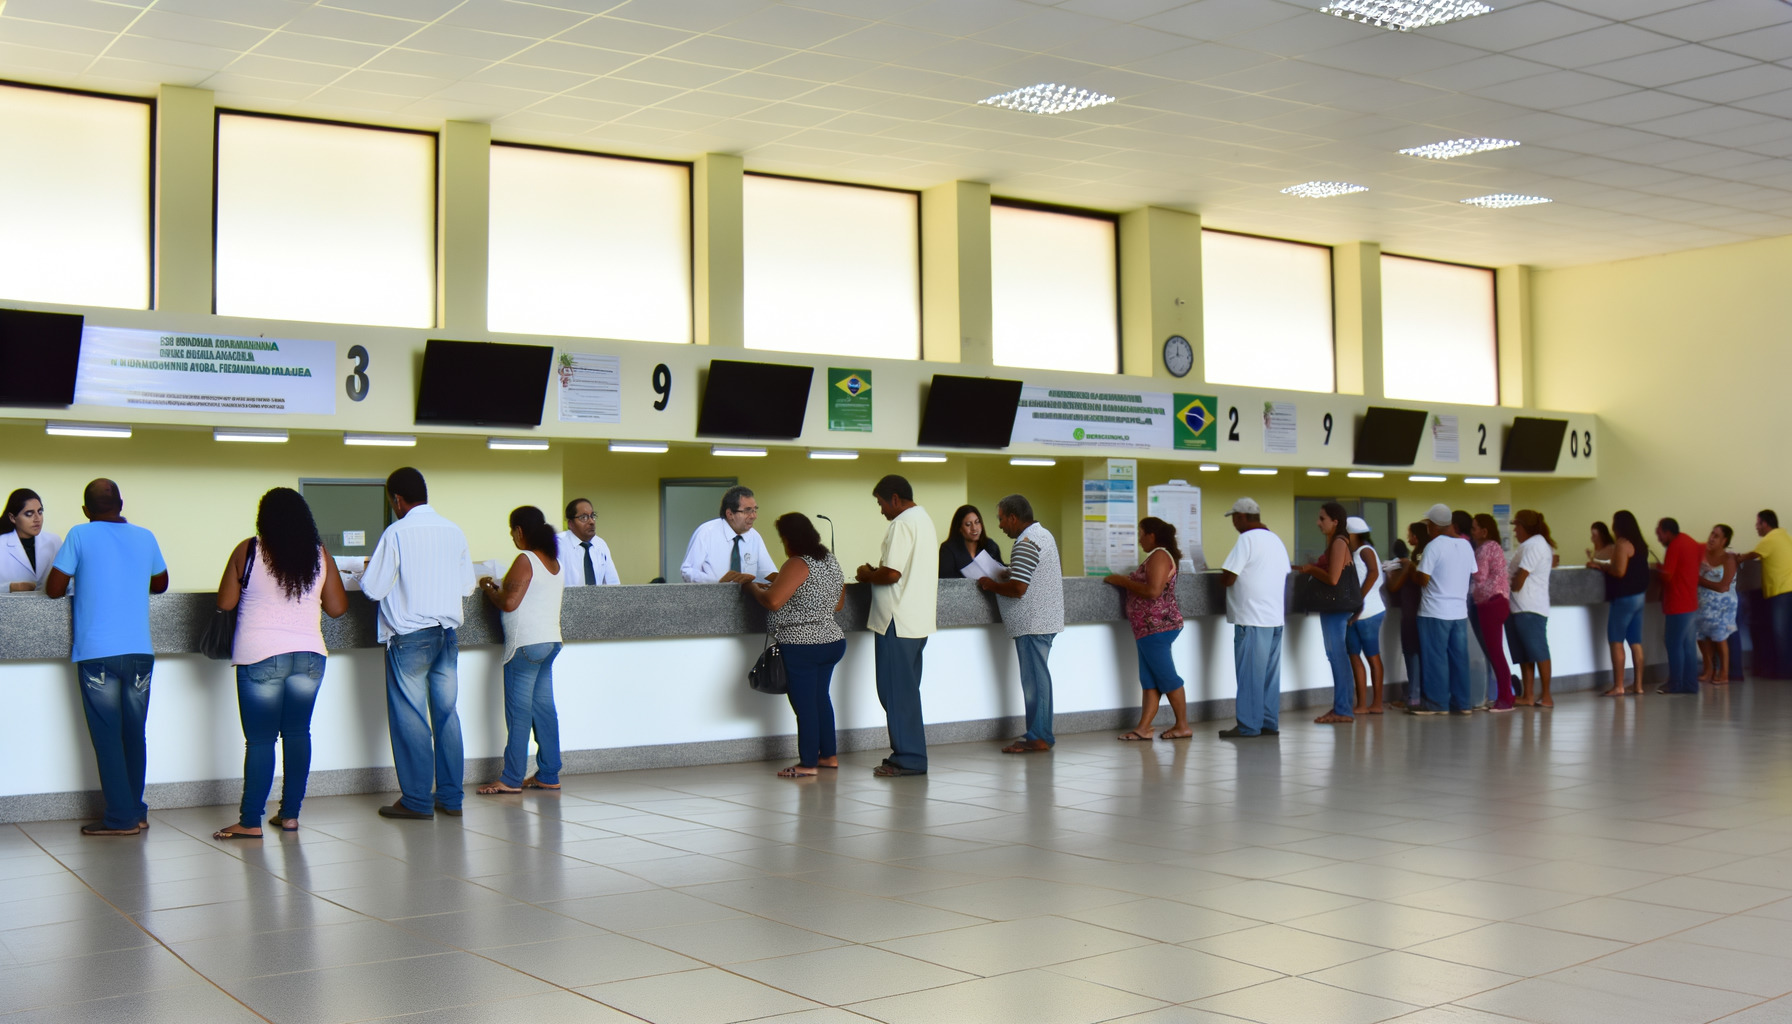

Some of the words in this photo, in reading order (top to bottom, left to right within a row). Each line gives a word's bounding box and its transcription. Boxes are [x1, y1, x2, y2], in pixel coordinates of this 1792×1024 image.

[345, 344, 370, 402] 3
[652, 363, 672, 412] 9
[1228, 406, 1240, 442] 2
[1322, 412, 1334, 446] 9
[1477, 423, 1487, 456] 2
